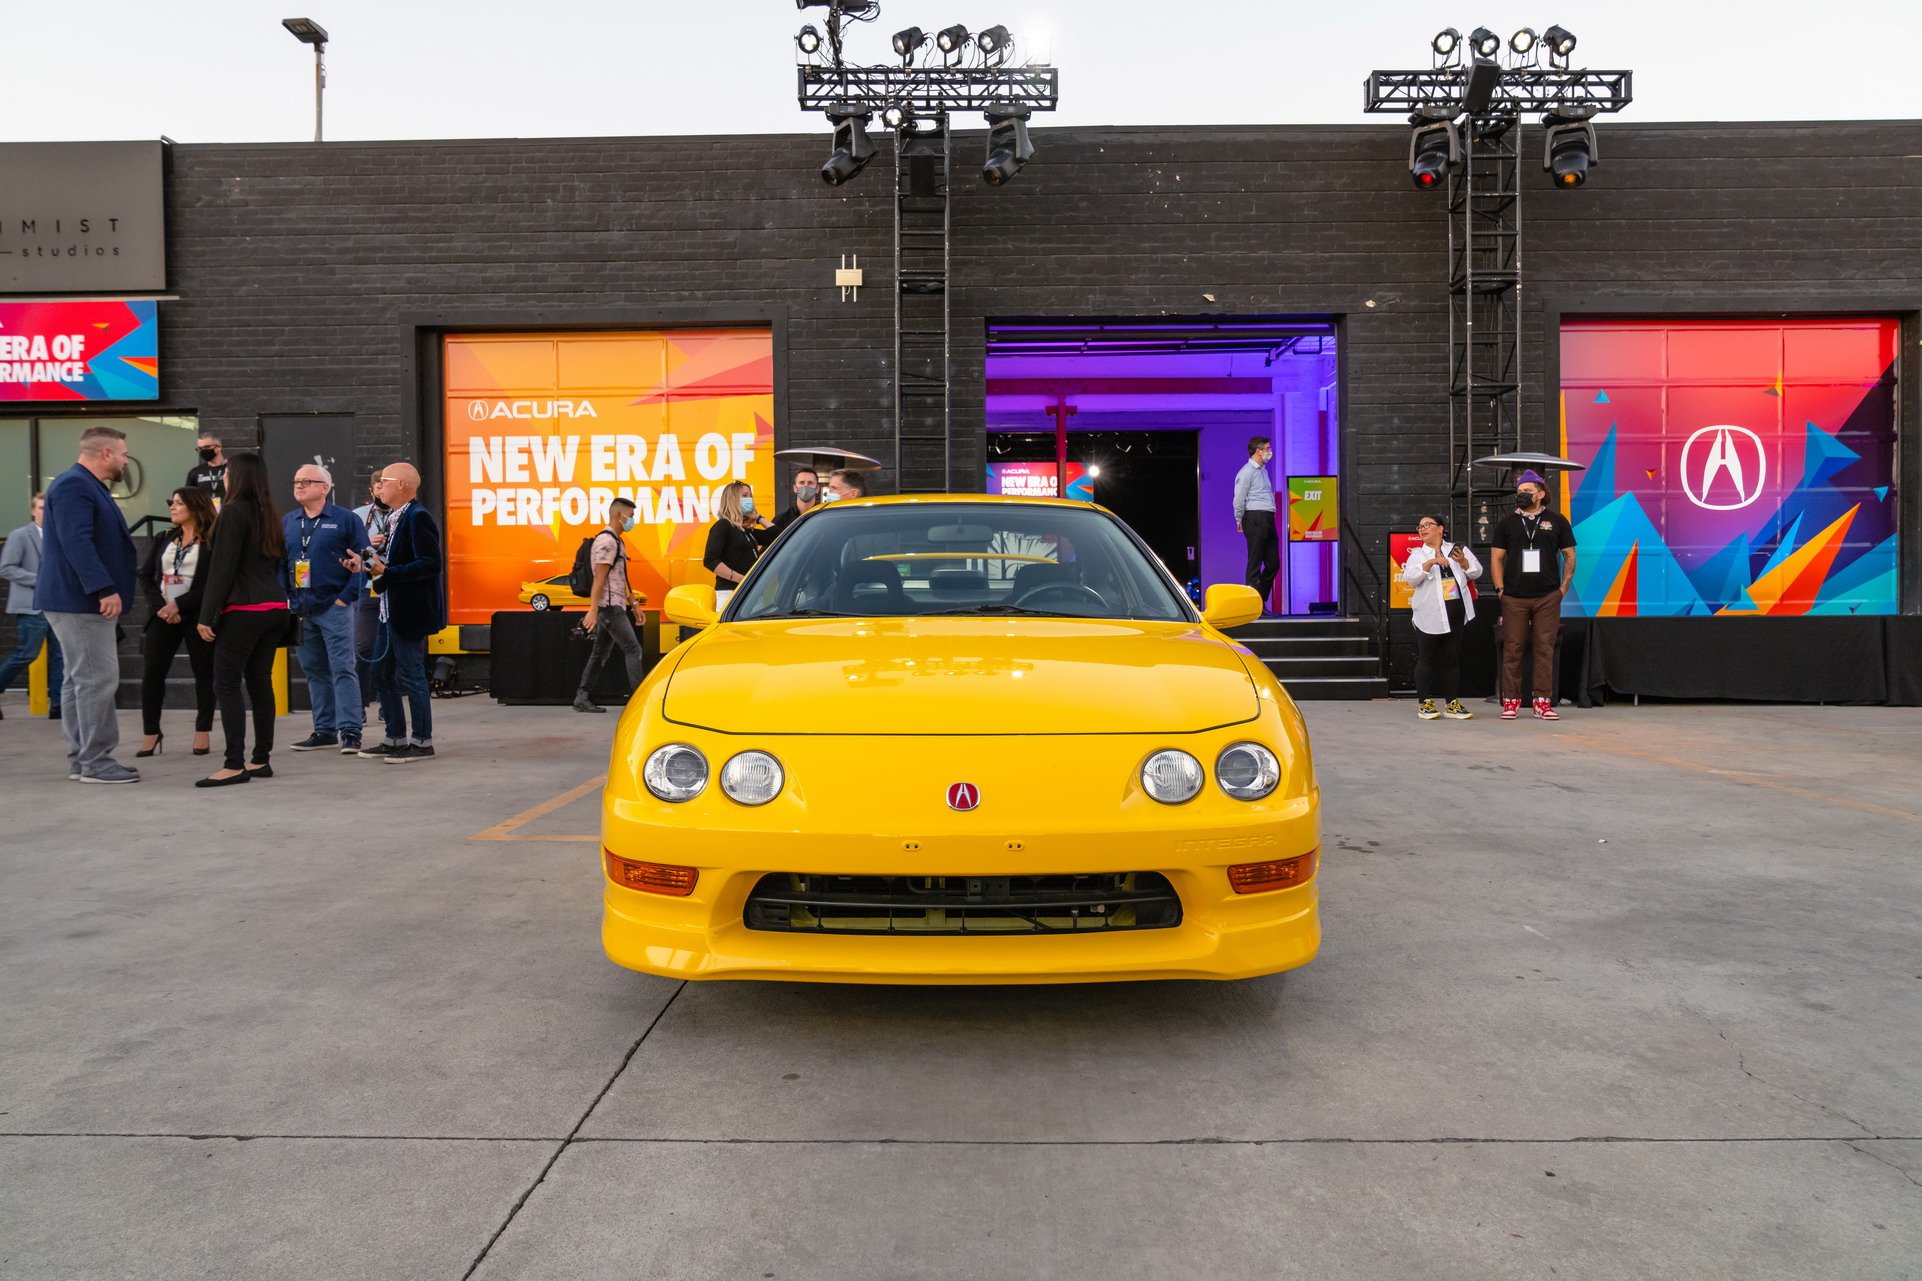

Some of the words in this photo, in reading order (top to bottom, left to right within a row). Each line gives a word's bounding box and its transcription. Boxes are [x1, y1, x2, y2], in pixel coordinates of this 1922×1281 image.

[22, 244, 120, 257] studios
[0, 335, 50, 361] ERA
[52, 334, 85, 361] OF
[0, 361, 84, 383] RMANCE
[490, 400, 598, 419] ACURA
[469, 435, 581, 483] NEW
[590, 433, 686, 481] ERA
[694, 432, 755, 481] OF
[1001, 476, 1027, 488] NEW
[1027, 476, 1049, 488] ERA
[471, 484, 754, 526] PERFORMAN
[1304, 490, 1323, 501] EXIT
[1174, 833, 1278, 852] INTEGRA
